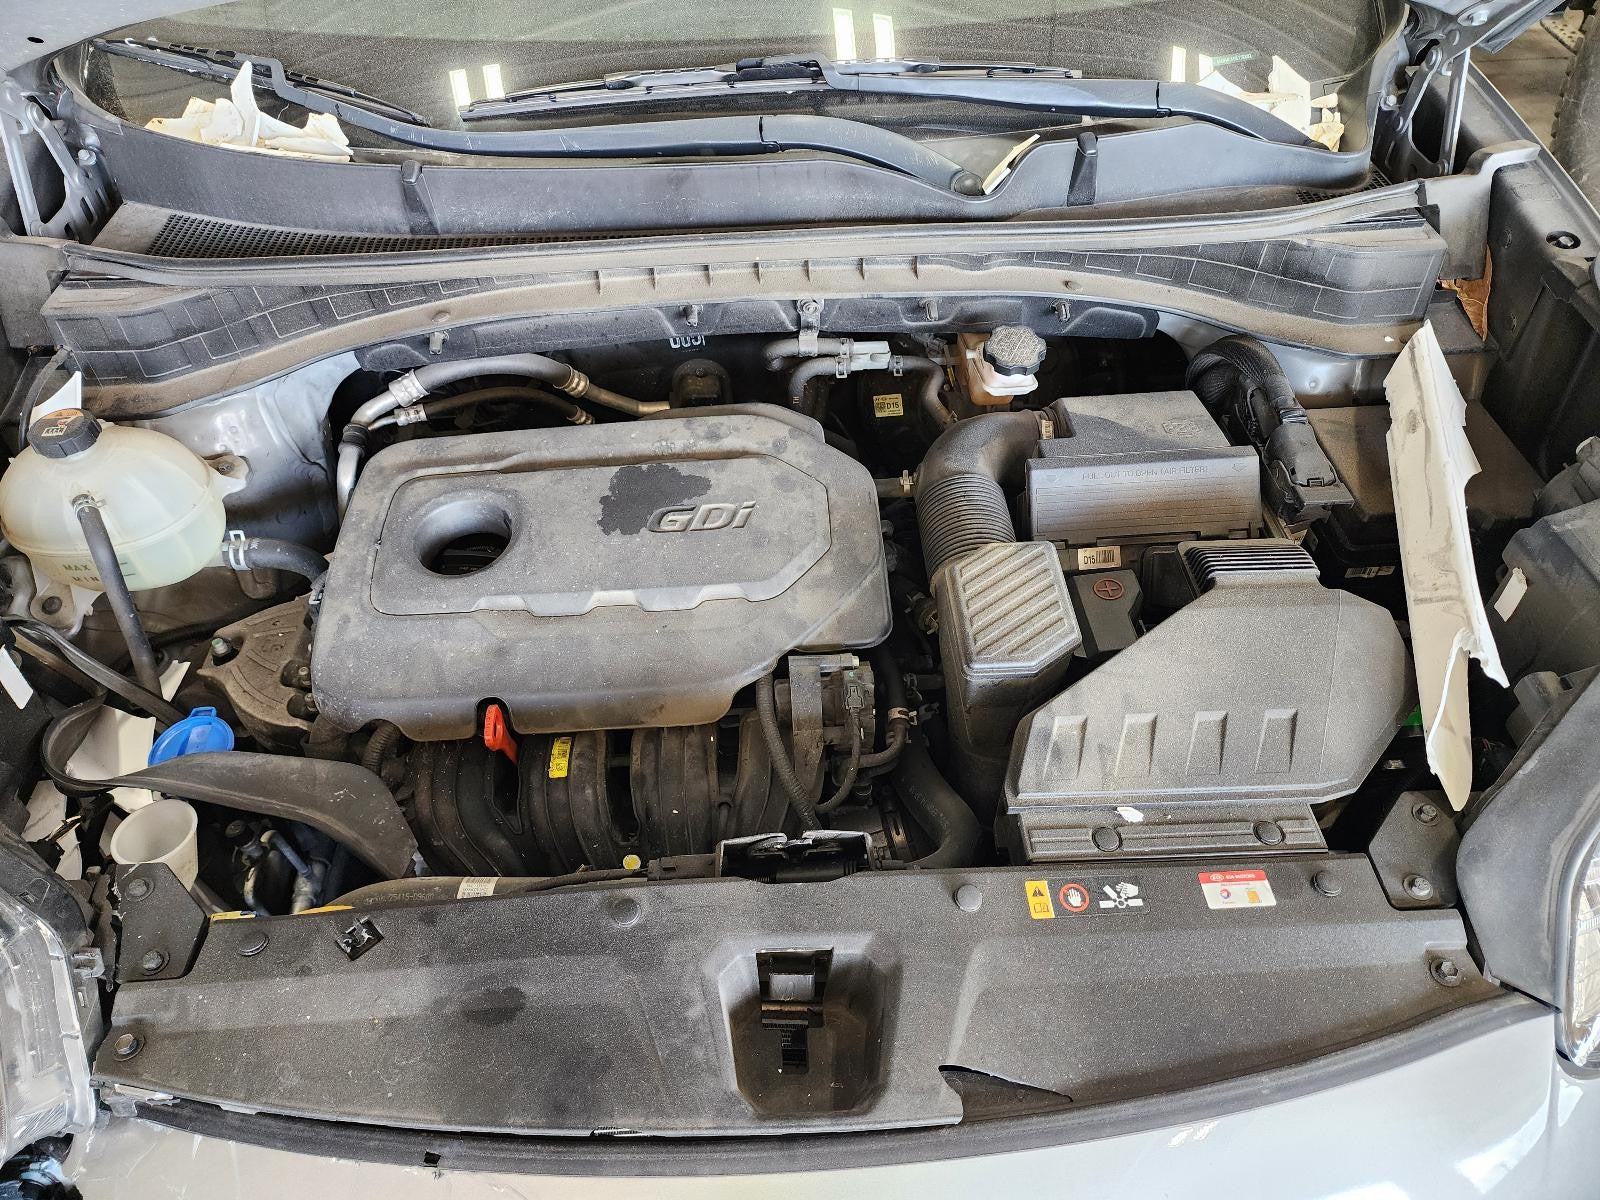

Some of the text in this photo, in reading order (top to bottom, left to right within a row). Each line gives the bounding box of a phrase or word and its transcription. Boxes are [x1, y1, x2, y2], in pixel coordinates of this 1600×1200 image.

[886, 401, 900, 410] D15
[646, 501, 757, 533] GDi
[1083, 555, 1096, 565] D15
[63, 564, 91, 572] MAX
